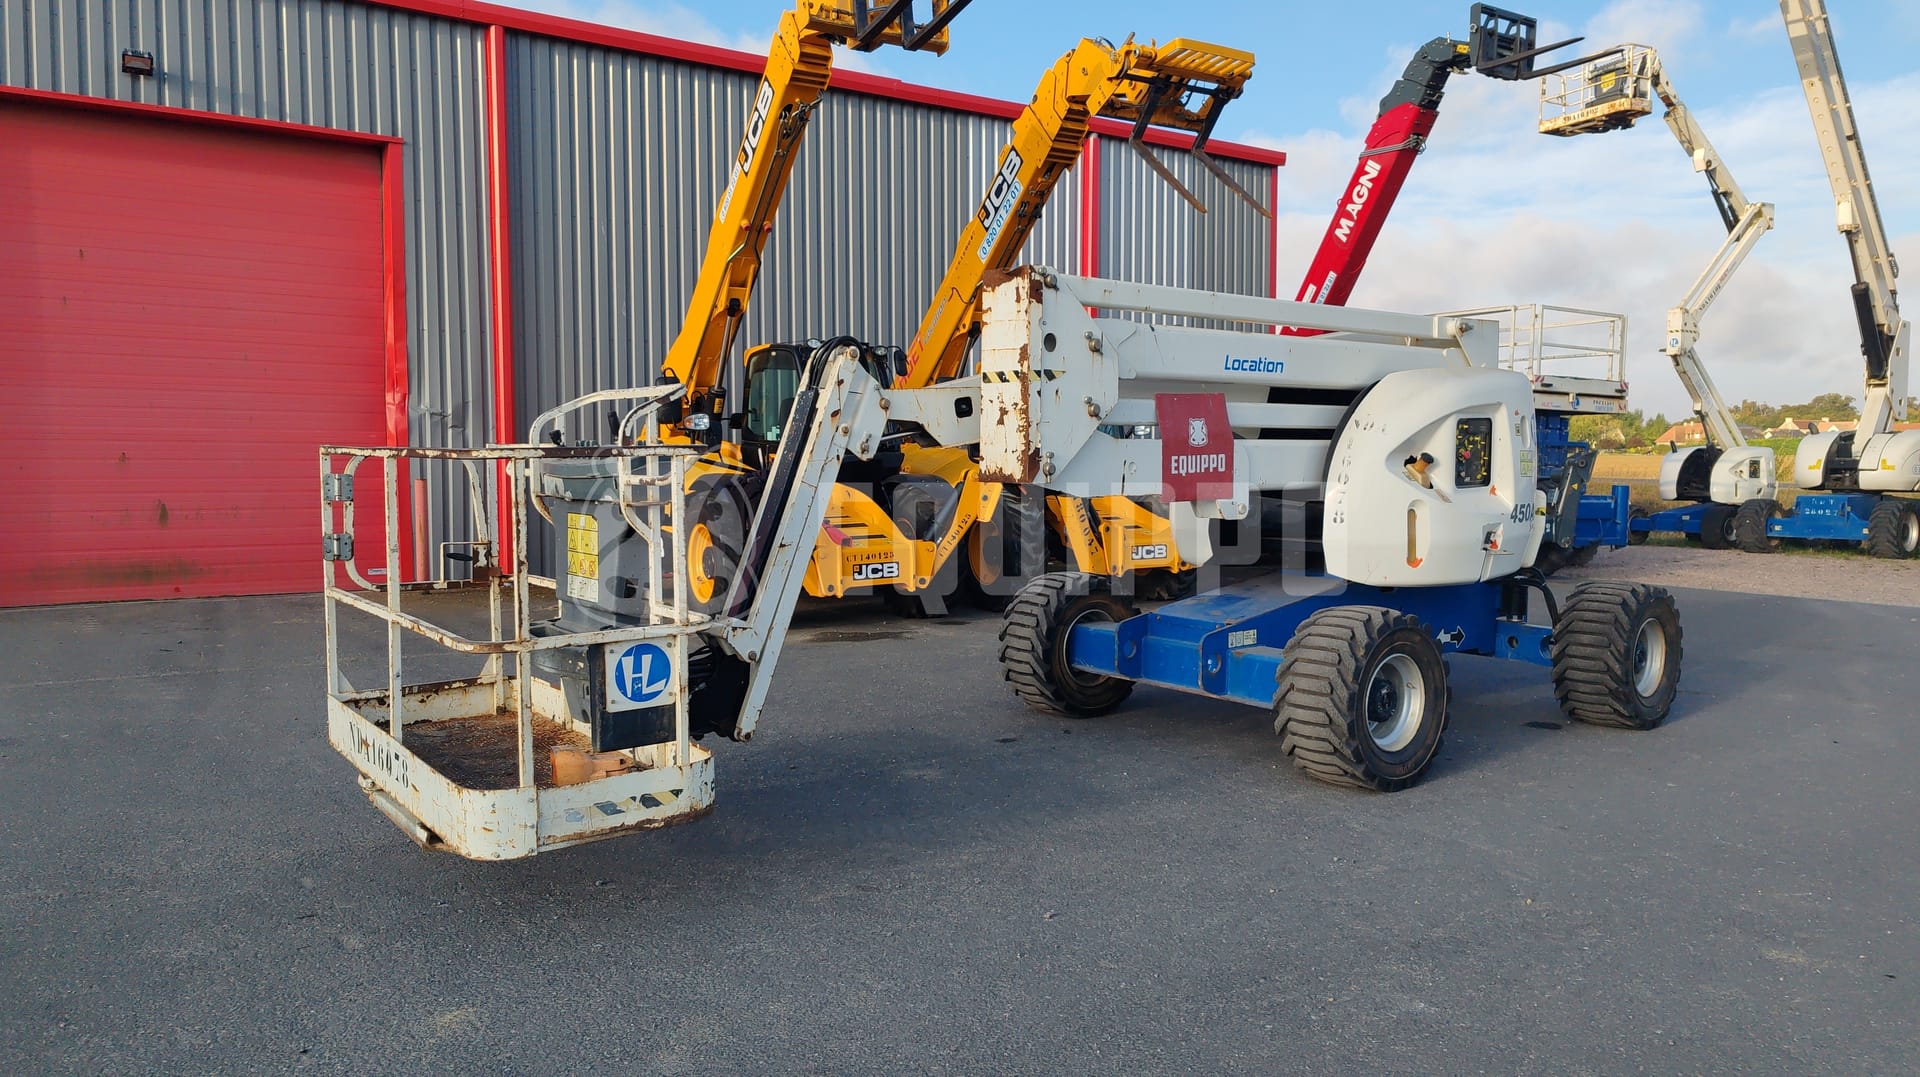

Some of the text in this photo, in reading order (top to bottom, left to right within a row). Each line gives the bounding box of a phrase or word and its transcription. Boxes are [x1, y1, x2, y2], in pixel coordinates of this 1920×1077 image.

[741, 79, 774, 174] JCB
[982, 149, 1022, 229] JCB
[1334, 159, 1382, 243] MAGNI
[981, 186, 1020, 256] 0 820 01 22 01
[1224, 354, 1284, 374] Location
[1171, 453, 1226, 477] EQUIPPO
[1074, 497, 1099, 556] 80047
[1131, 545, 1167, 560] JCB
[853, 562, 899, 580] JCB
